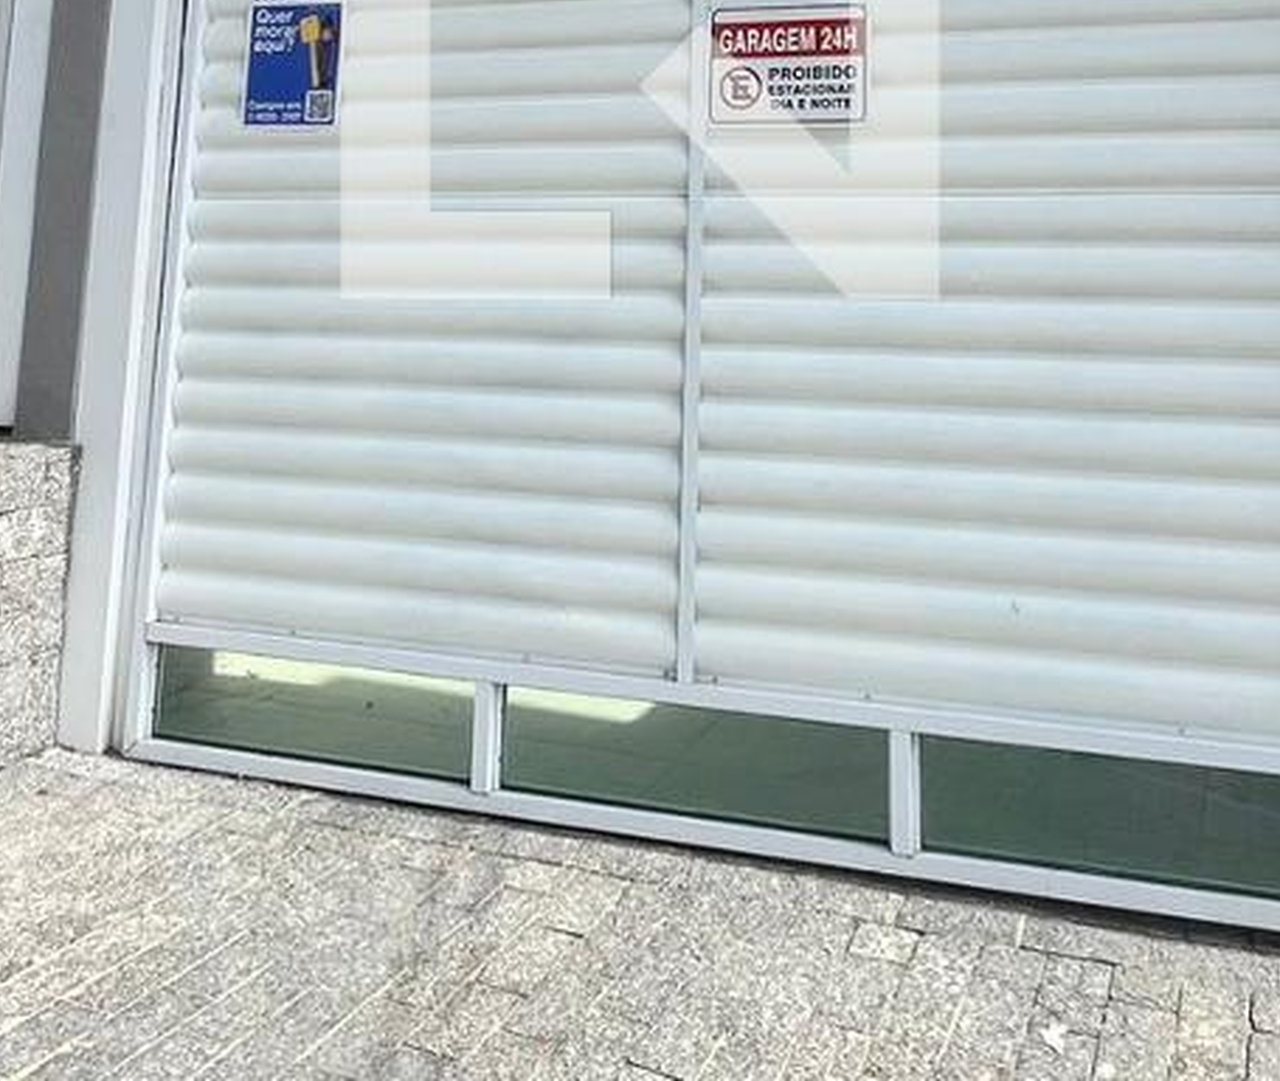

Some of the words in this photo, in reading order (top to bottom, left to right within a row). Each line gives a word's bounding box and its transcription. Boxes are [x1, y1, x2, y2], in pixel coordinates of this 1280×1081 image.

[255, 8, 294, 24] Quer
[253, 39, 295, 55] aqui?
[719, 27, 817, 53] GARAGEM
[820, 26, 858, 51] 24H
[768, 65, 857, 81] PROIBIDO
[770, 99, 794, 110] DIA
[798, 99, 806, 109] E
[810, 98, 852, 110] NOITE
